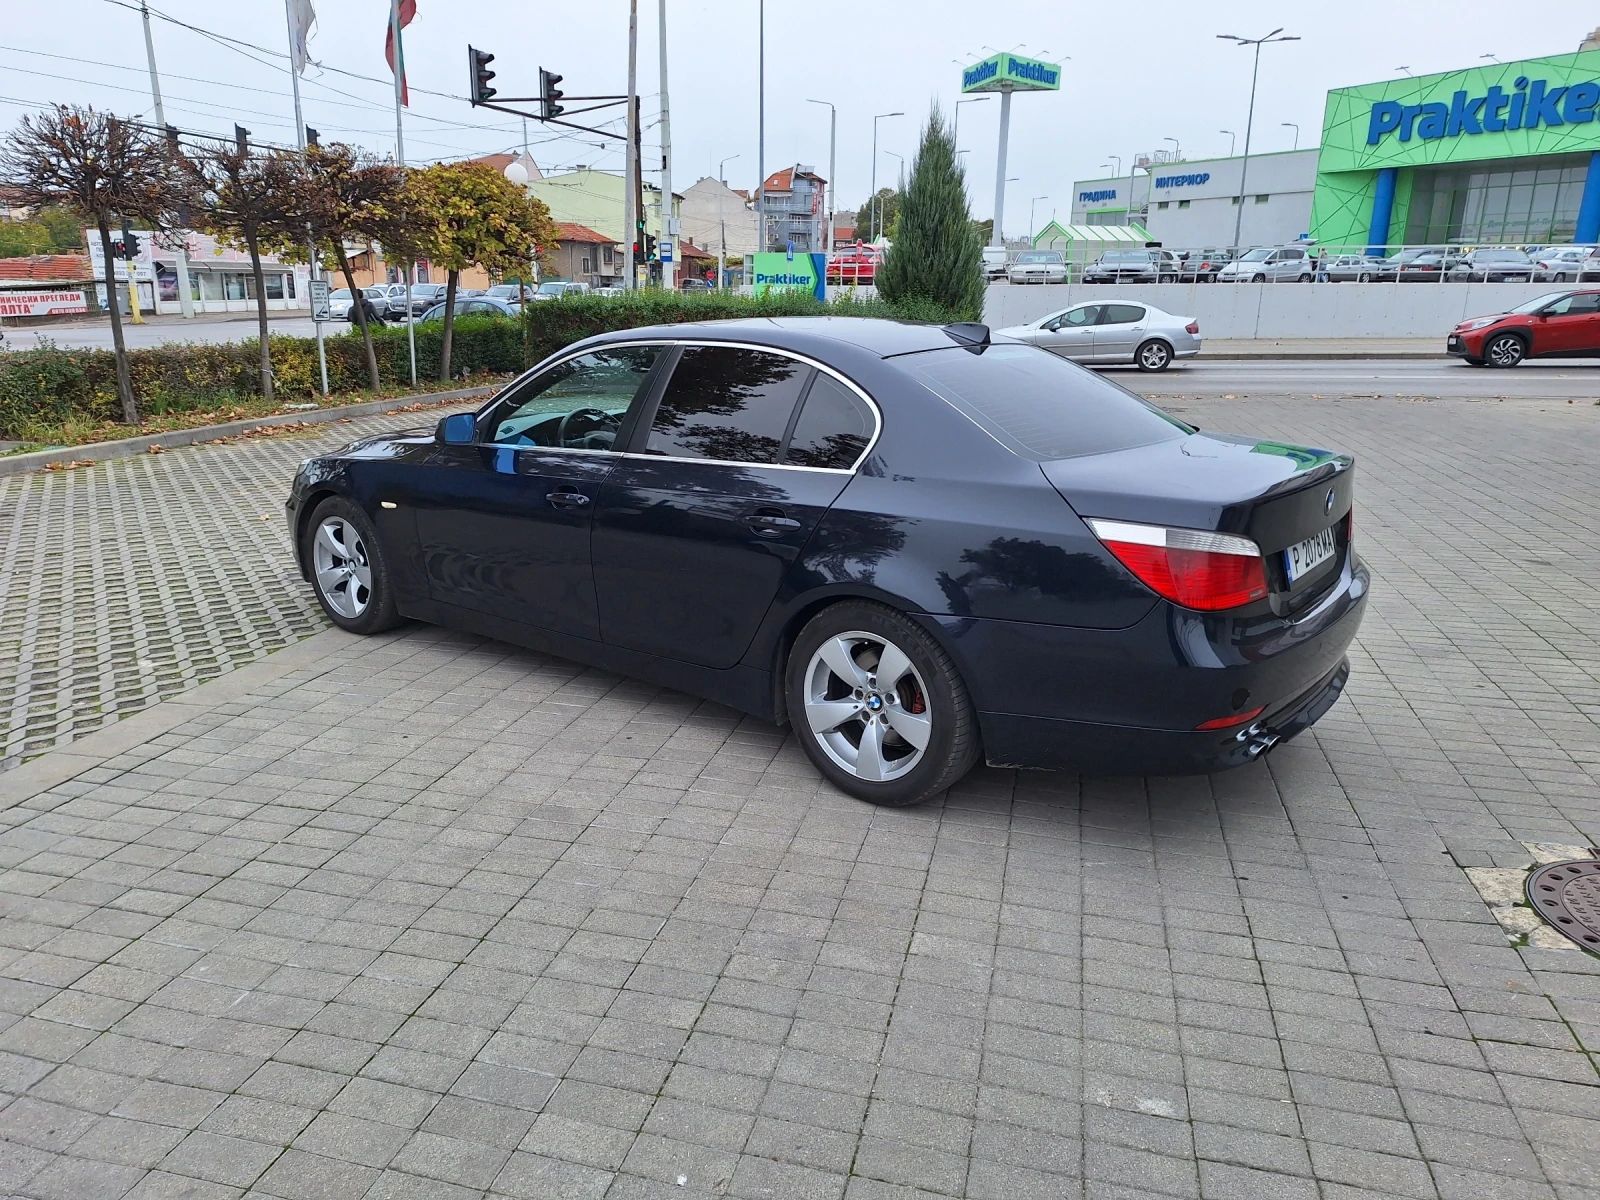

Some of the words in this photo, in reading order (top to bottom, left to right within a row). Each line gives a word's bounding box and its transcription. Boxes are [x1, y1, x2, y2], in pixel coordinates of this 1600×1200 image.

[964, 61, 999, 88] Praktiker
[1008, 57, 1058, 85] Praktiker
[1366, 76, 1600, 146] Praktike
[1155, 173, 1210, 188] ИНТЕРИОР
[1079, 190, 1117, 203] ГРАДИНА
[756, 273, 811, 285] Praktiker
[39, 293, 81, 303] ПРЕГЛЕДИ
[1292, 546, 1300, 575] P
